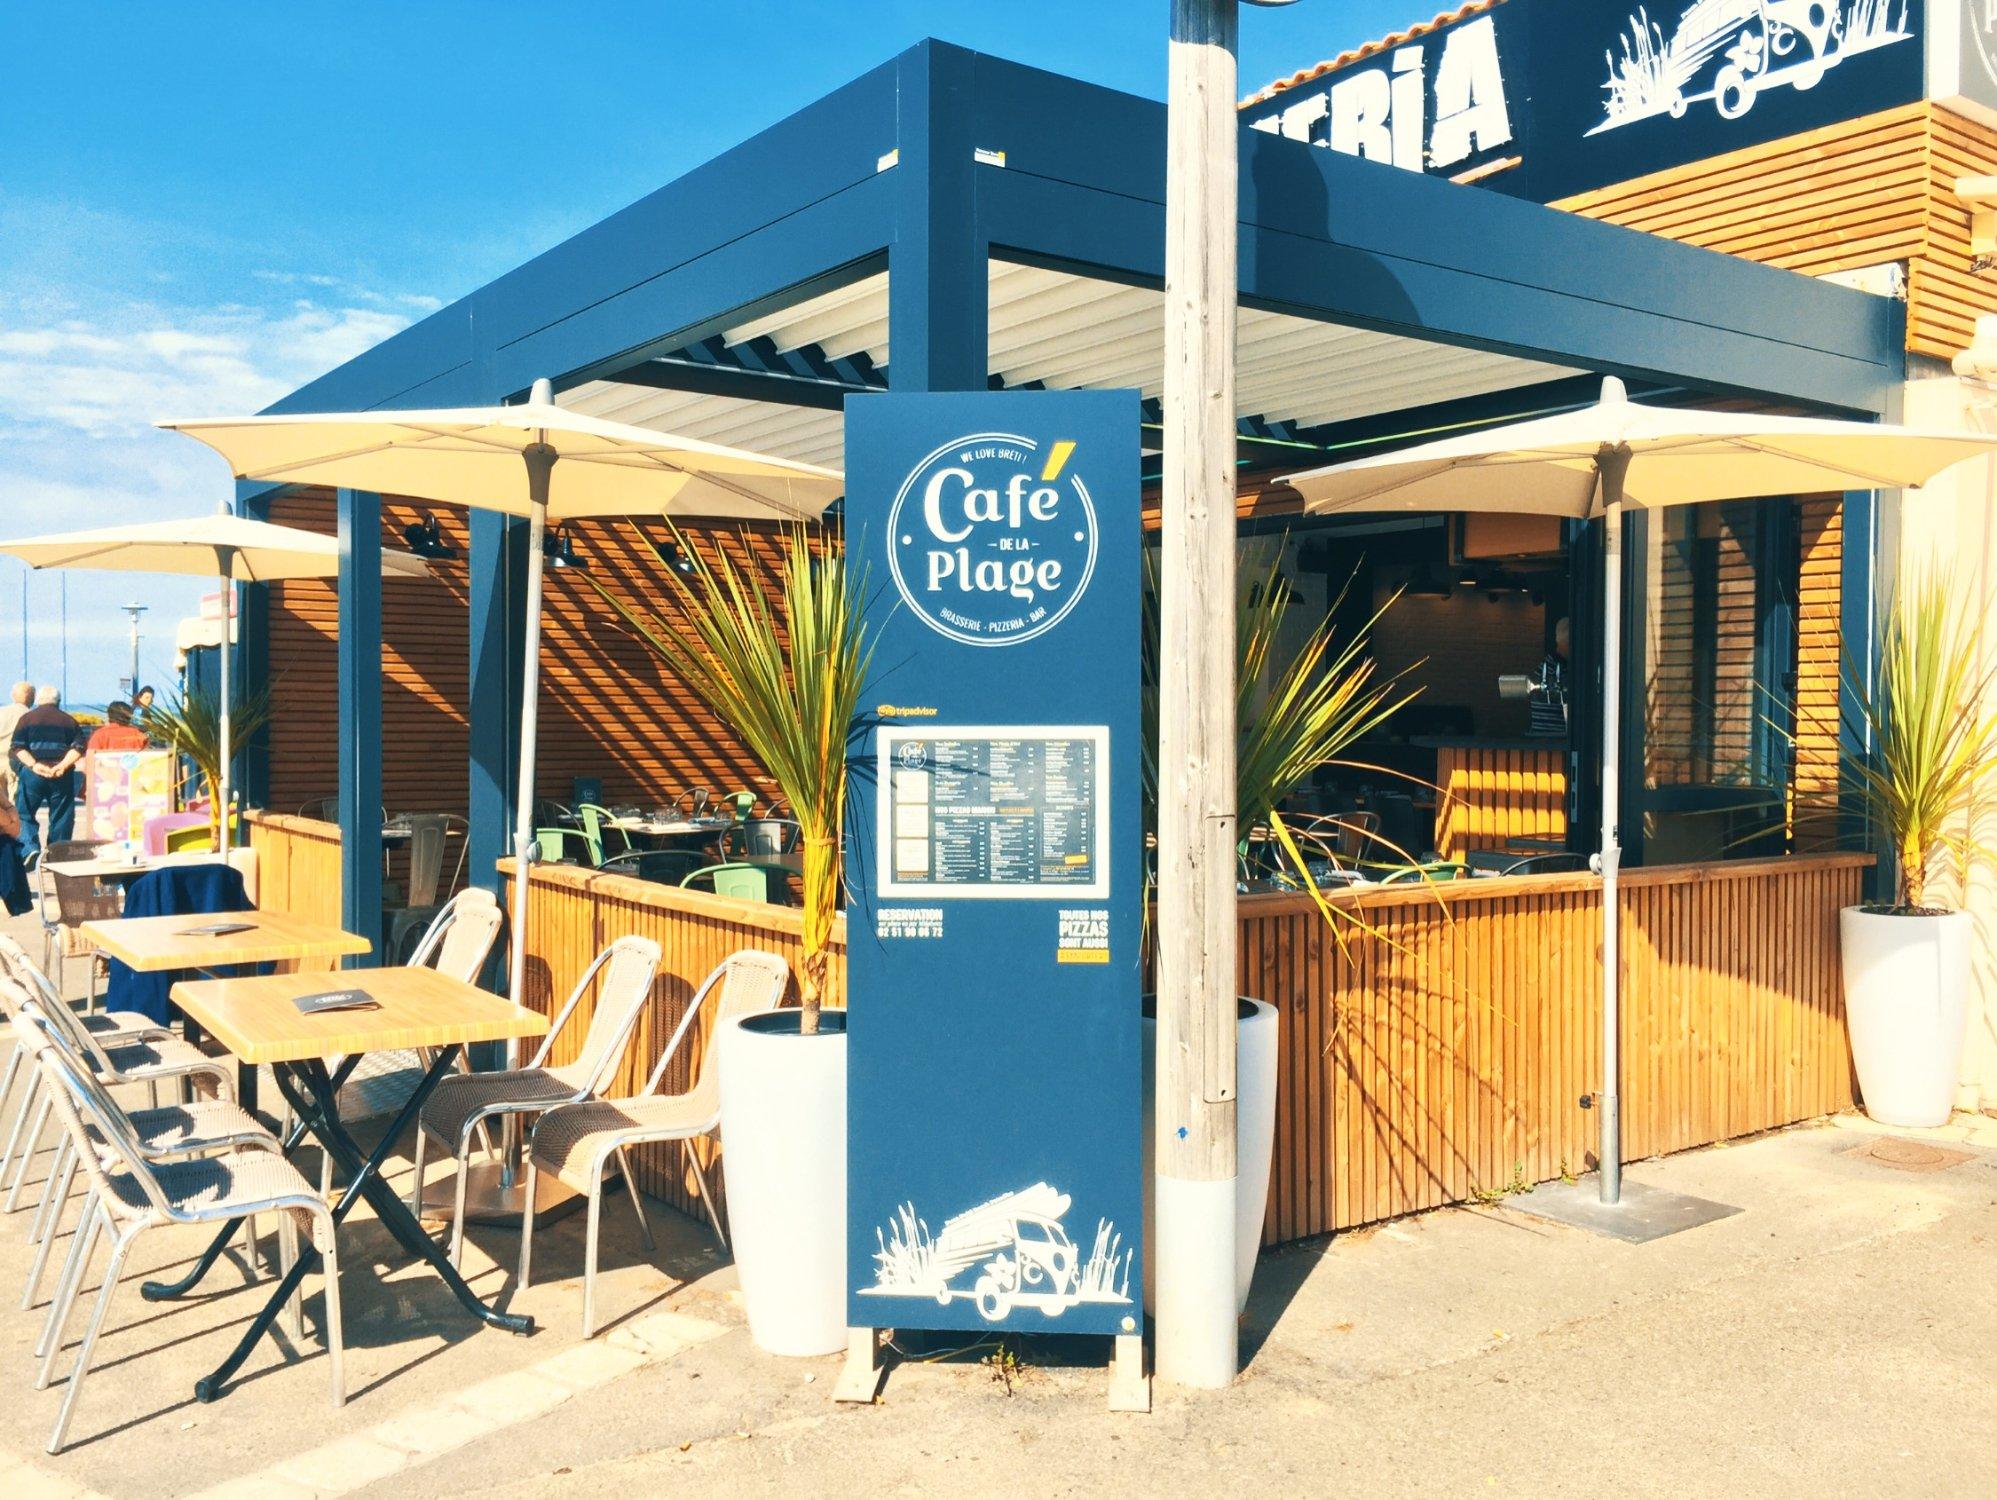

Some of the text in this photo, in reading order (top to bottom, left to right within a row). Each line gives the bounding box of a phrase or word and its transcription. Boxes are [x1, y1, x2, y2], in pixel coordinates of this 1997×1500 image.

[960, 450, 974, 464] WE
[975, 448, 996, 460] LOVE
[924, 441, 1077, 543] Café
[1000, 538, 1029, 551] DE LA
[927, 547, 1062, 604] Plage
[939, 606, 1047, 633] BRASSERIE PIZZERIA BAR
[896, 706, 938, 717] tripadvisor
[1058, 909, 1109, 921] TOUTES NOS
[1059, 920, 1109, 937] PIZZAS
[1058, 937, 1082, 949] SONT
